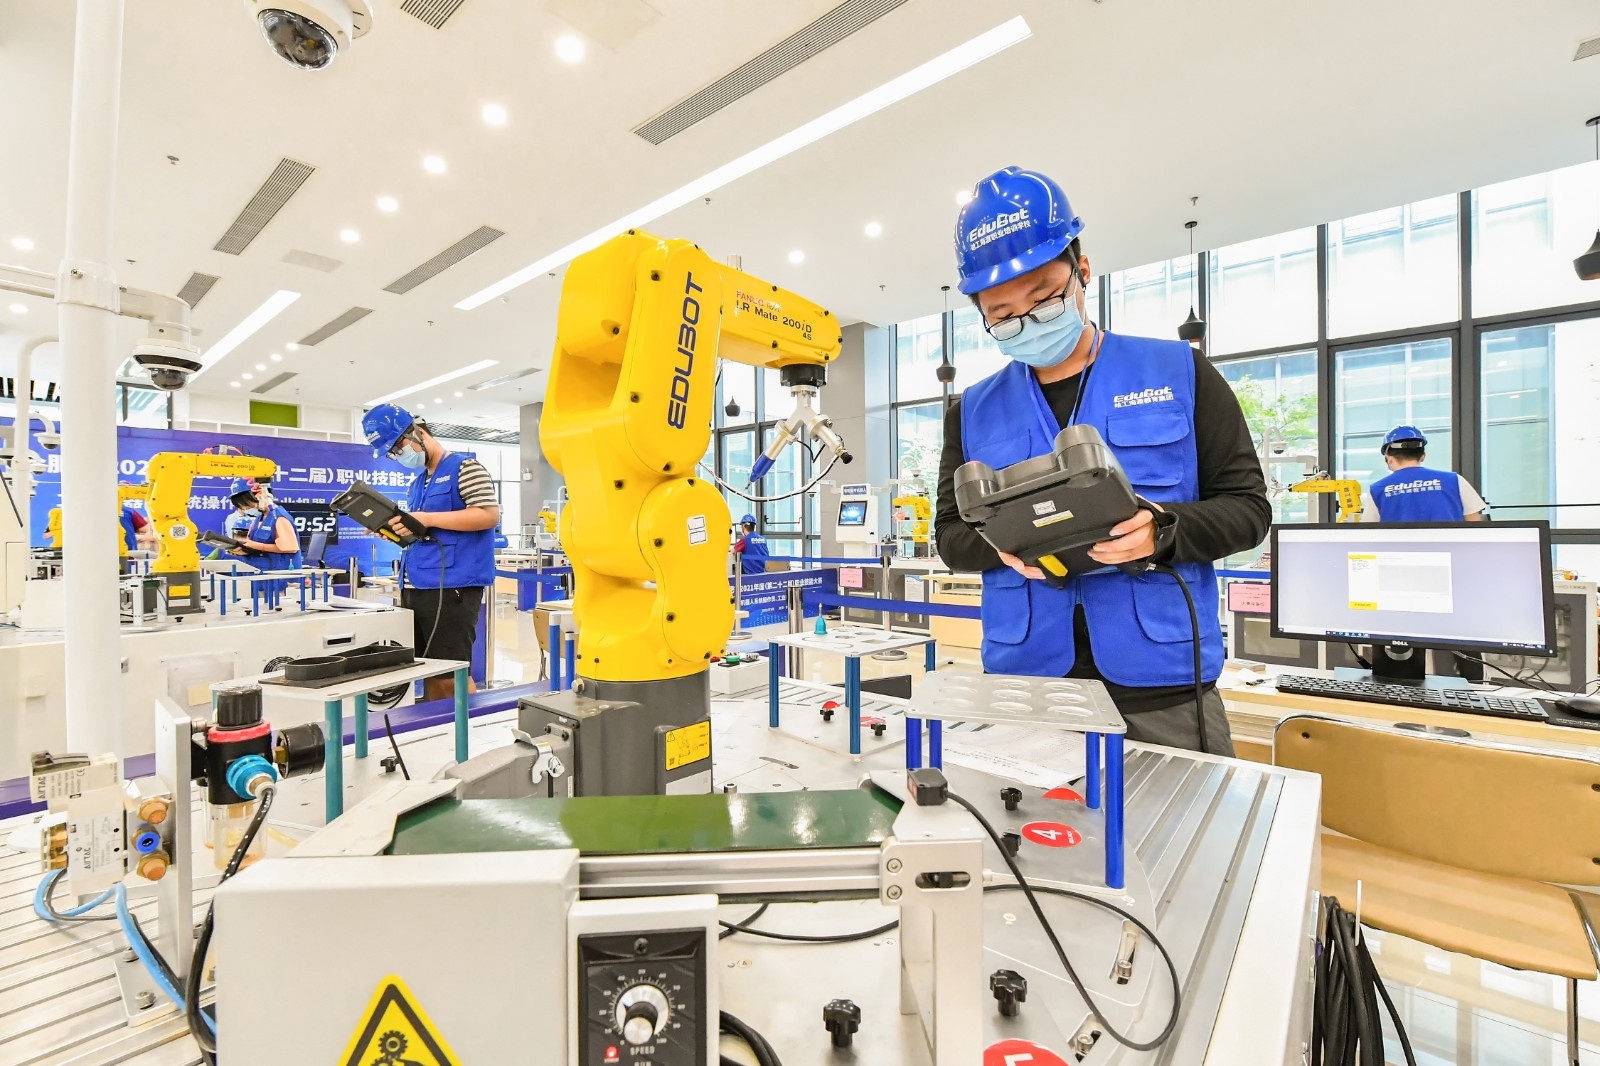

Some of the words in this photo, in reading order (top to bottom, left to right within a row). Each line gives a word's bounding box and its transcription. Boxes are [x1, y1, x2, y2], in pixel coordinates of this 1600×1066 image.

[969, 208, 1029, 242] EduBot
[736, 290, 764, 307] FANUC
[755, 306, 778, 322] Mate
[667, 271, 703, 430] EDUBOT
[1114, 386, 1173, 403] EduBot
[1384, 479, 1441, 493] EduBot
[1031, 828, 1062, 841] 4
[630, 1046, 655, 1056] SPEED
